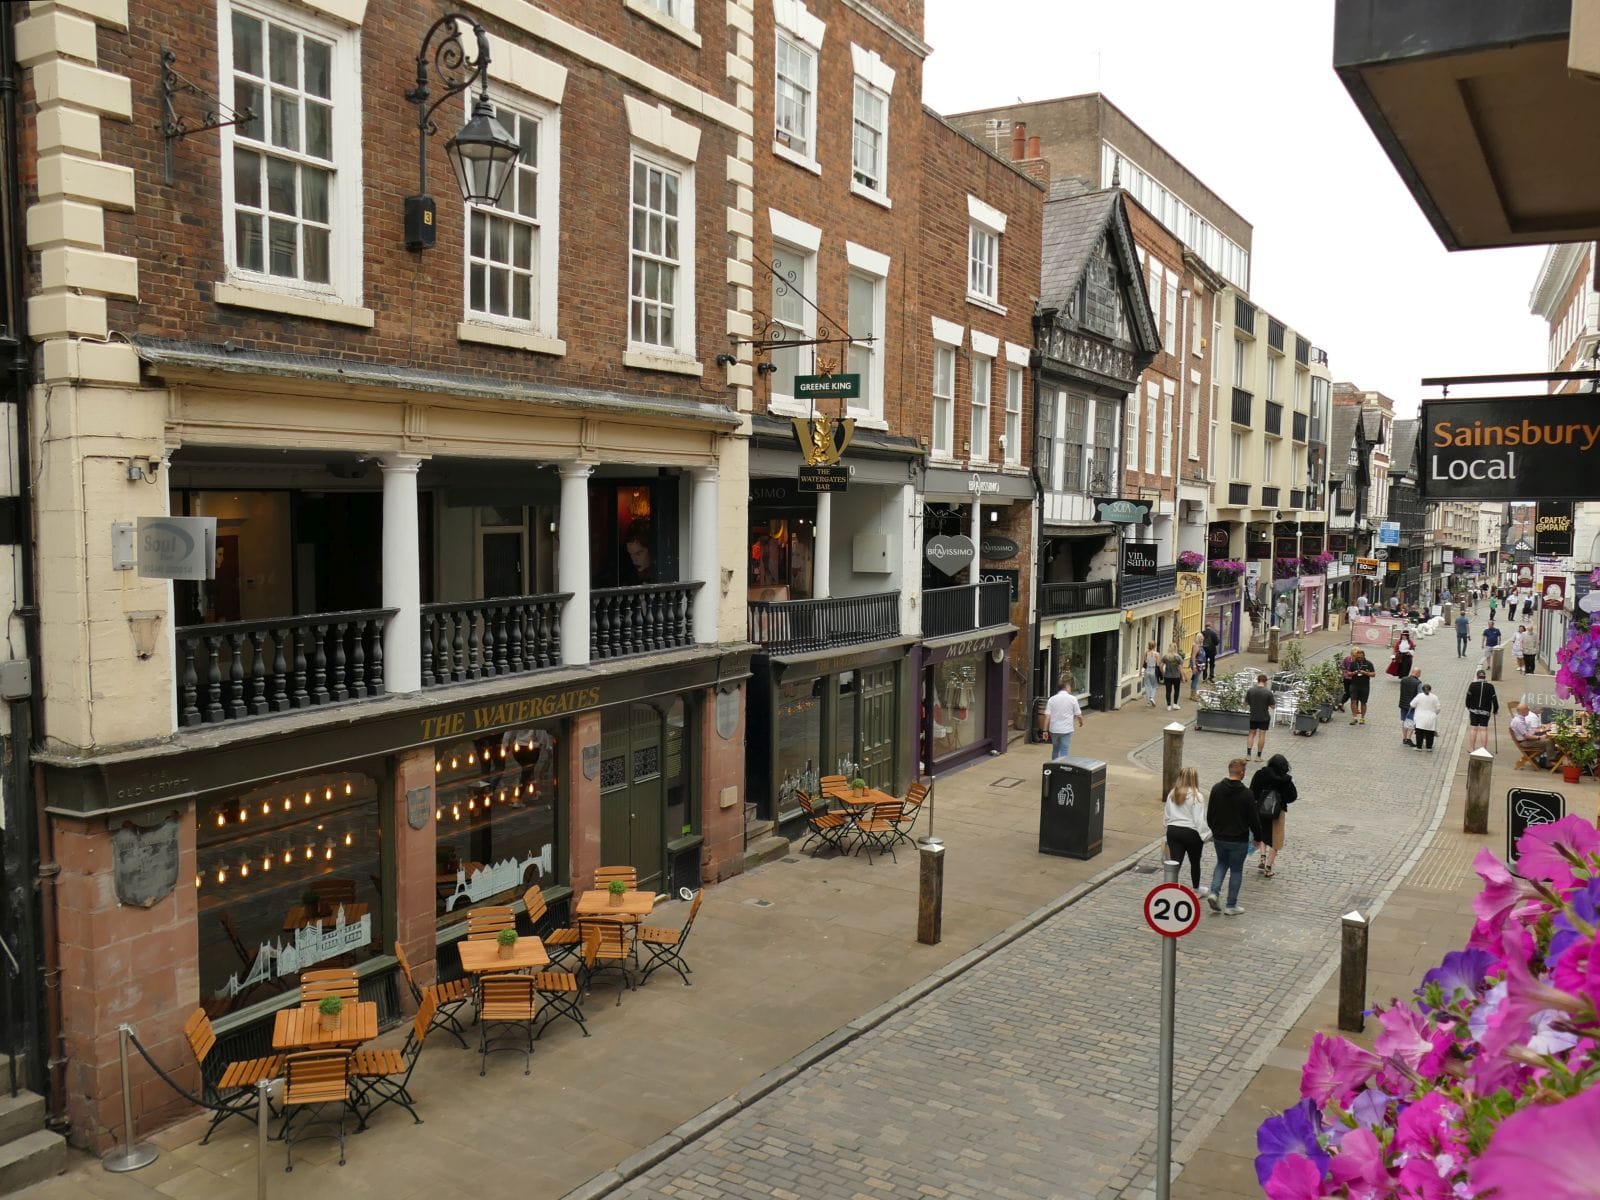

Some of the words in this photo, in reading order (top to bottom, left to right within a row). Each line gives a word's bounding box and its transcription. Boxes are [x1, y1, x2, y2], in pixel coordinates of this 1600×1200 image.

[800, 383, 830, 391] GREENE
[831, 382, 852, 390] KING
[1432, 451, 1516, 480] Local
[801, 475, 847, 483] WATERGATES
[144, 534, 176, 552] Soul
[927, 544, 973, 558] BRAVISSIMO
[1126, 557, 1155, 567] santo
[1128, 551, 1143, 560] vin
[945, 637, 995, 657] MORGAN
[421, 712, 465, 740] THE
[473, 687, 600, 728] WATERGATES
[1153, 898, 1193, 922] 20
